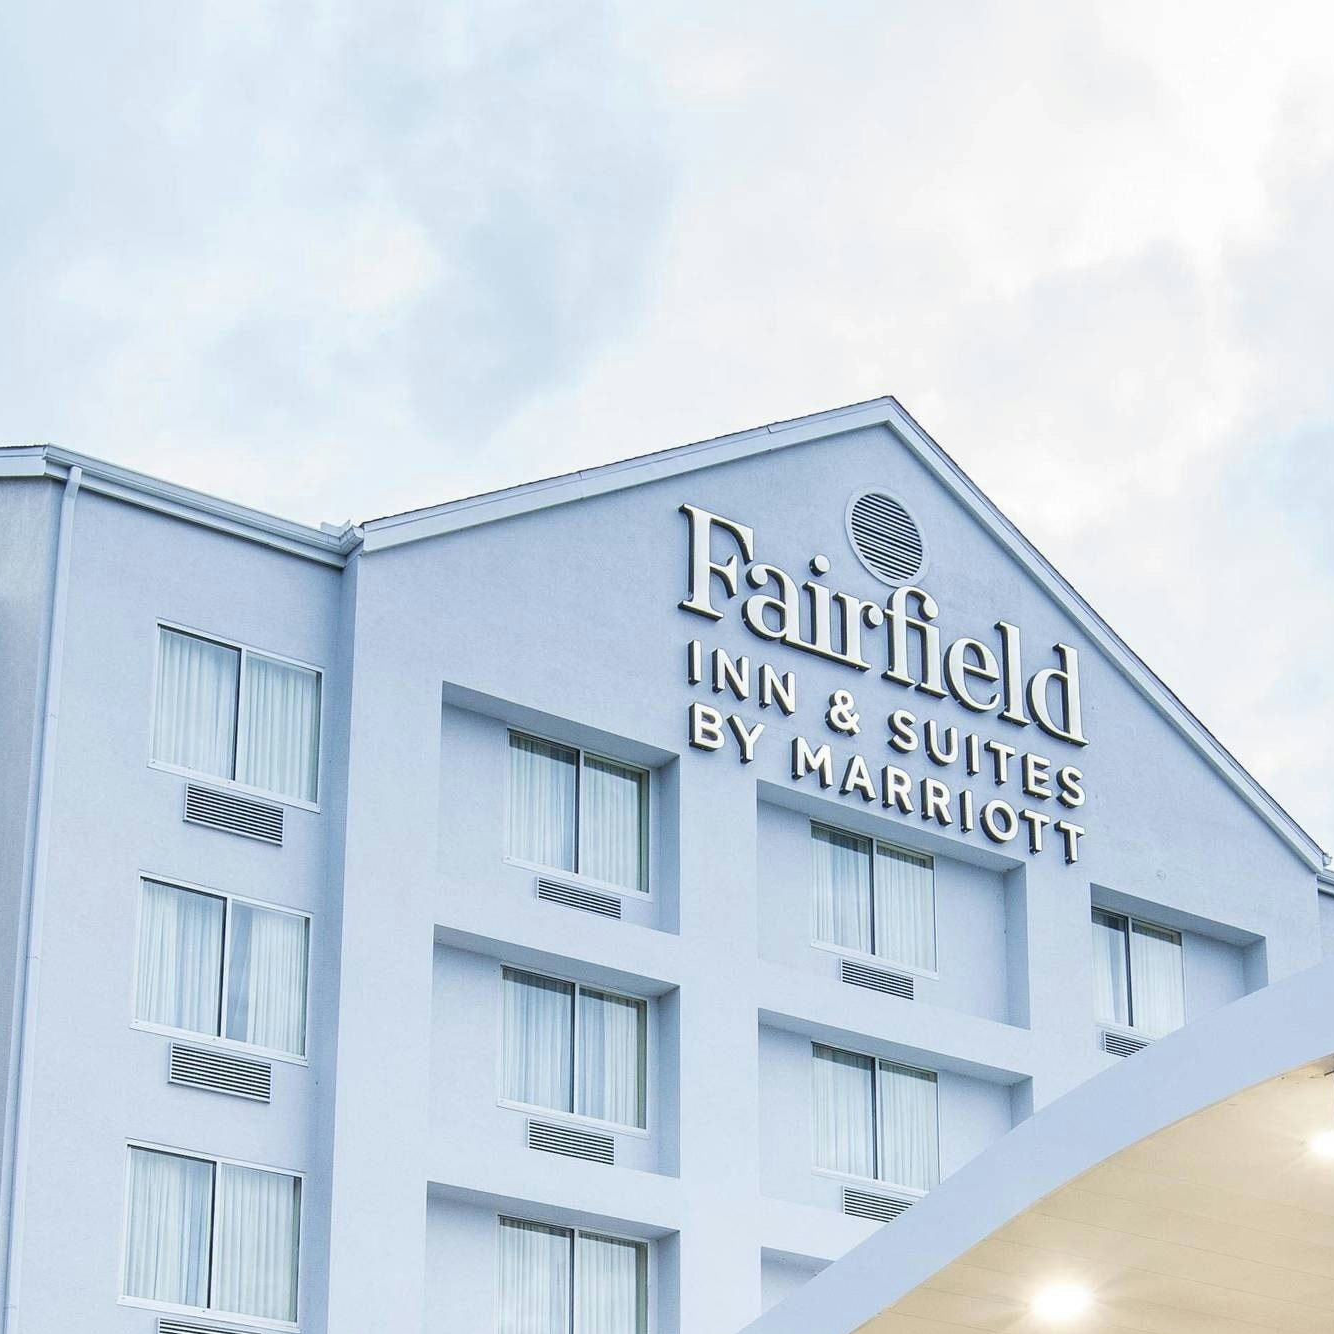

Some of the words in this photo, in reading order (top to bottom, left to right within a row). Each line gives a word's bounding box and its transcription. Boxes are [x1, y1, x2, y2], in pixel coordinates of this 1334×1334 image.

[677, 503, 1090, 747] Fairfield
[688, 639, 796, 716] INN
[825, 689, 861, 737] &
[887, 709, 1086, 808] SUITES
[689, 702, 765, 764] BY
[791, 736, 1086, 864] MARRIOTT
